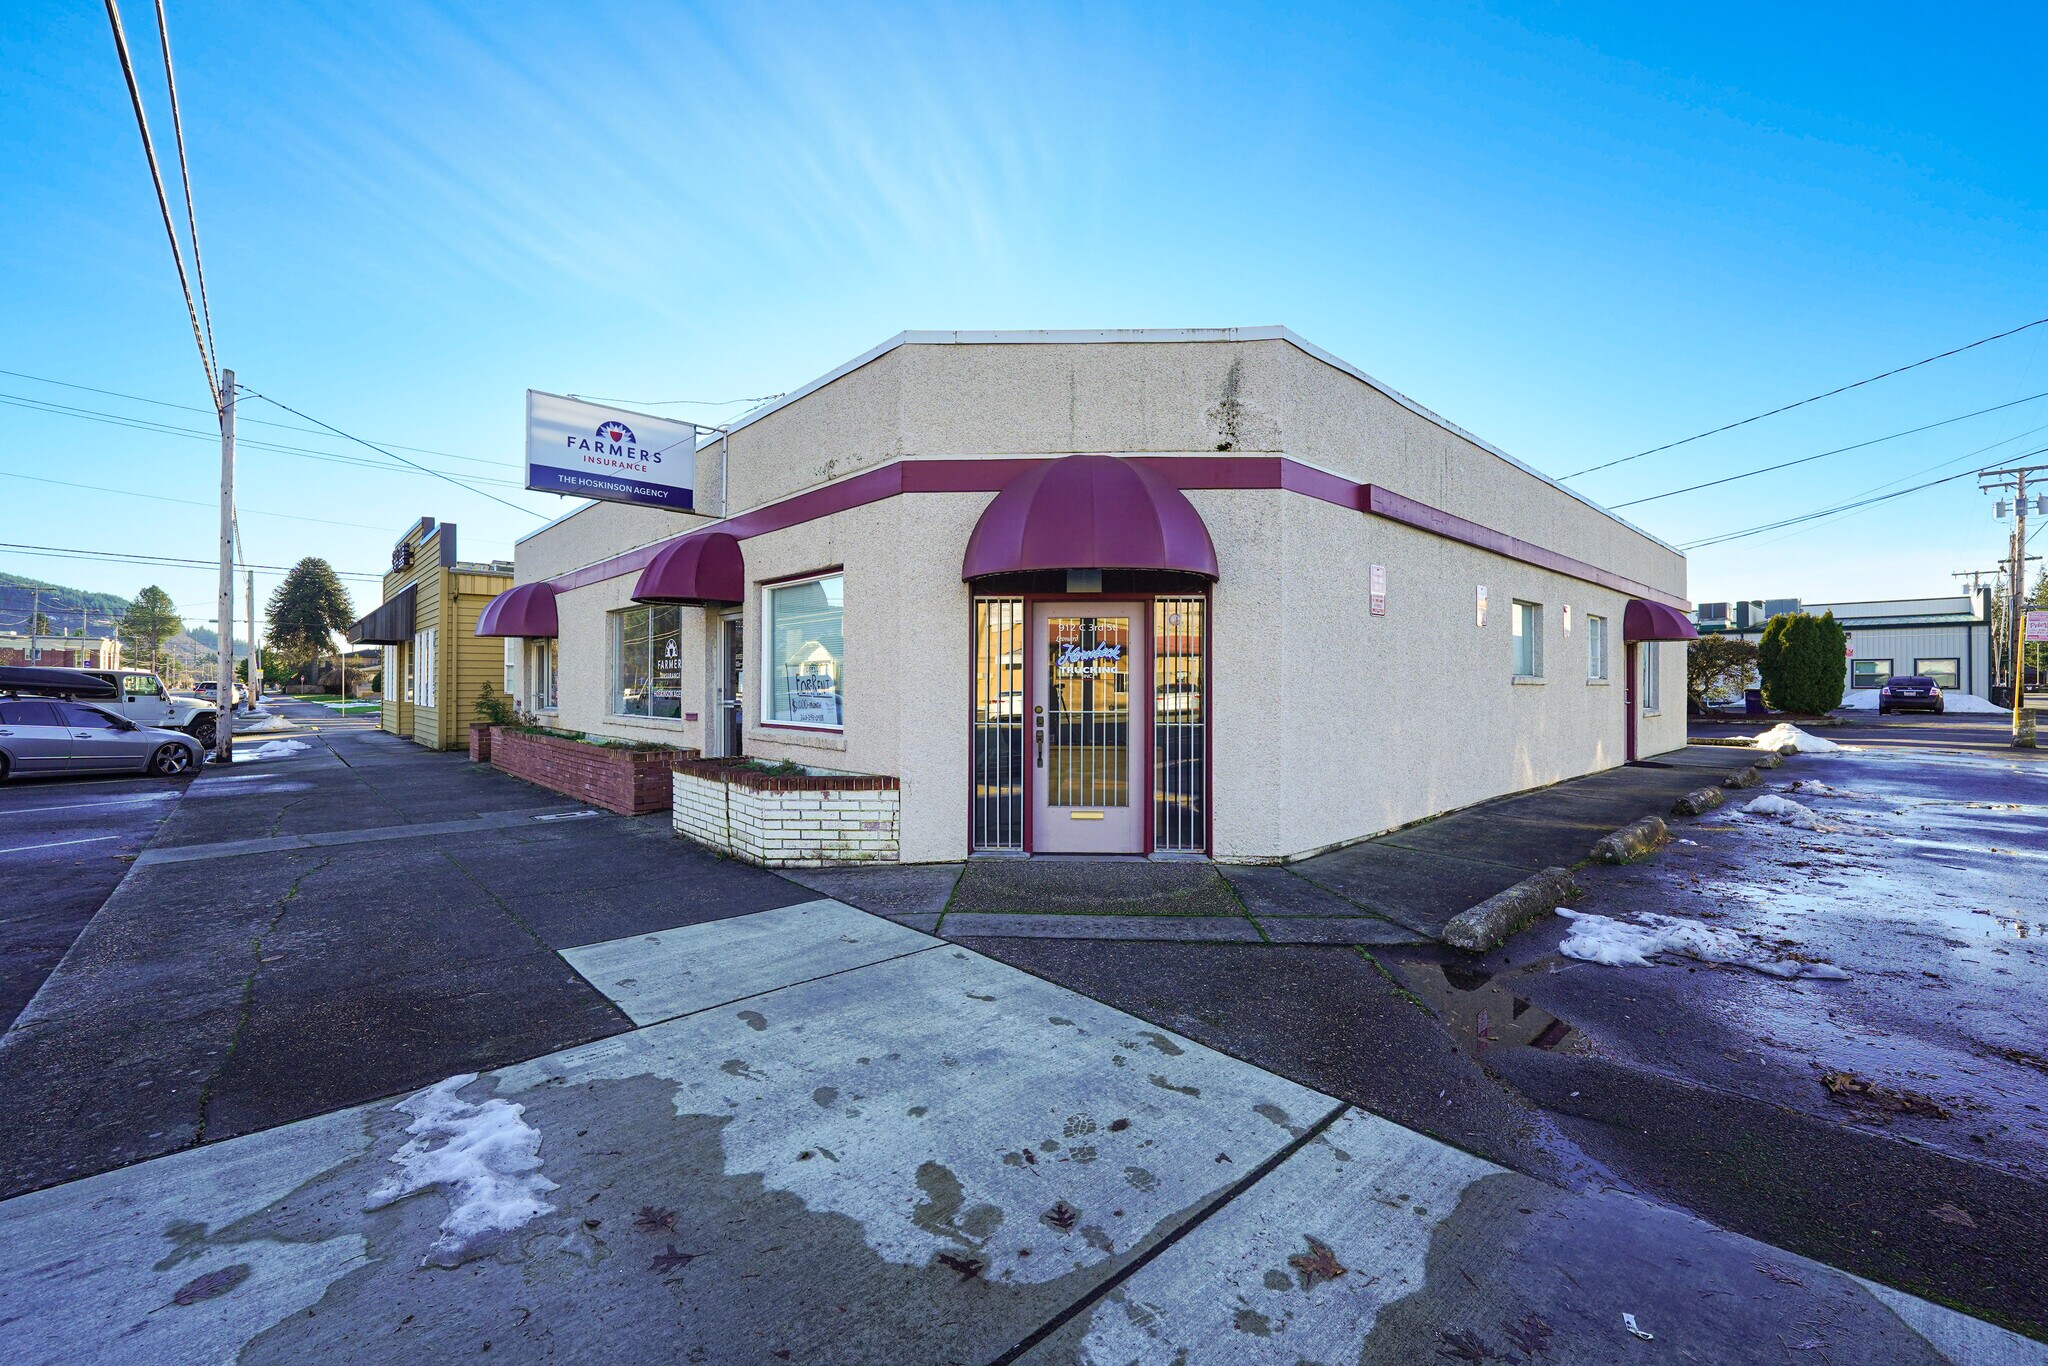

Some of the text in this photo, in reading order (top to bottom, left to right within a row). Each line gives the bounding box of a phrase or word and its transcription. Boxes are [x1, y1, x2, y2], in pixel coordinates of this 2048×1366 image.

[567, 435, 662, 464] FARMERS
[583, 455, 647, 472] INSURANCE
[558, 474, 669, 498] THE HOSKINSON AGENCY
[1058, 624, 1076, 632] 912
[1088, 623, 1104, 632] 3rd
[657, 659, 682, 669] FARMER
[1060, 666, 1118, 674] TRUCKING
